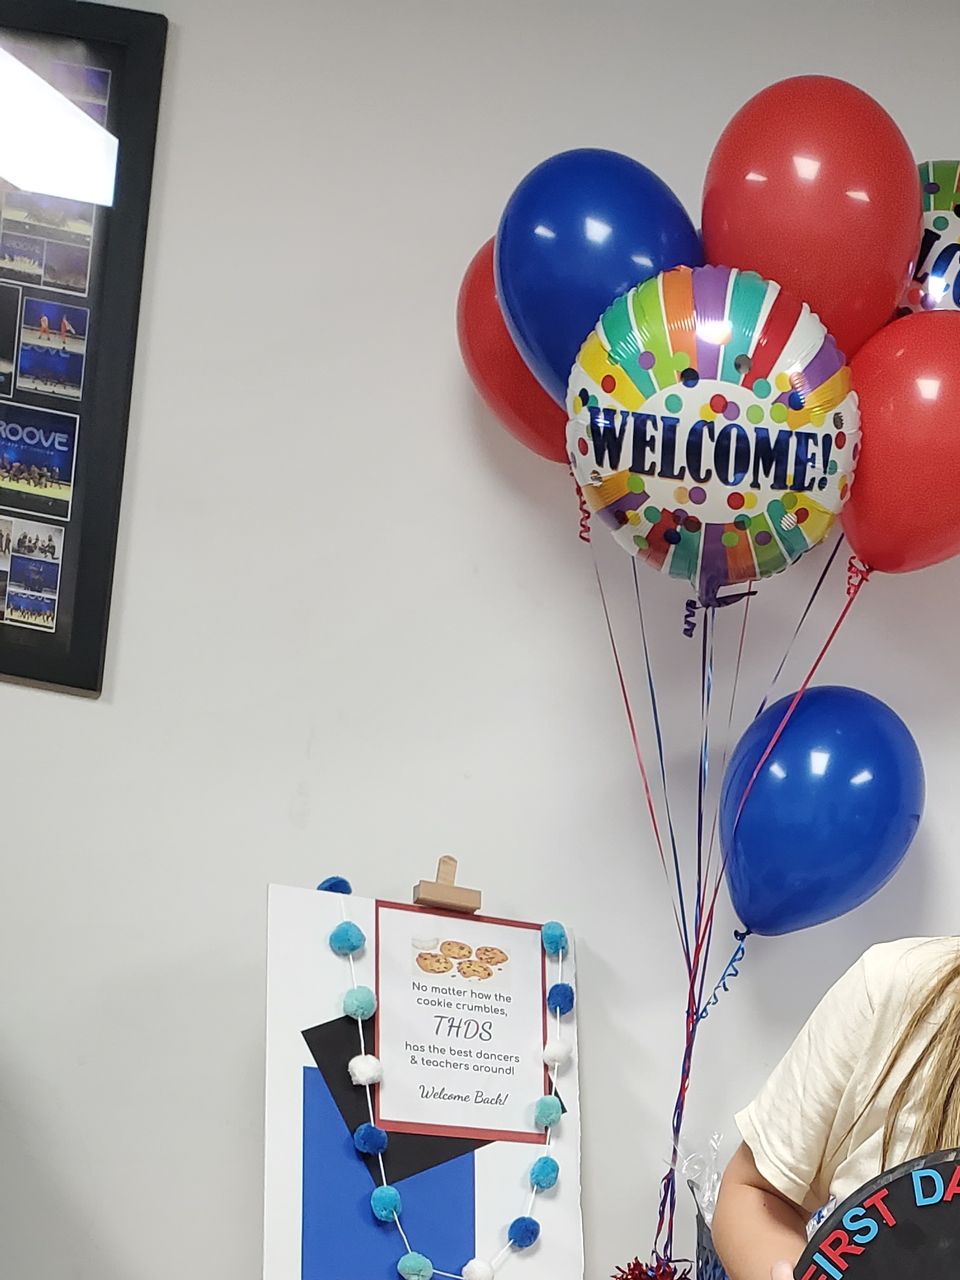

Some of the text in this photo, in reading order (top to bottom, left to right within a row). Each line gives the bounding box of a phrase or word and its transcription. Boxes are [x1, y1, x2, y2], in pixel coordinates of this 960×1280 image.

[587, 406, 834, 491] WELCOME!
[412, 981, 512, 1003] No matter how the
[416, 996, 508, 1017] cookie crumbles,
[433, 1015, 493, 1042] THDS
[405, 1041, 520, 1064] has the best dancers
[409, 1055, 515, 1076] & teachers around!
[418, 1084, 510, 1106] Welcome Back!
